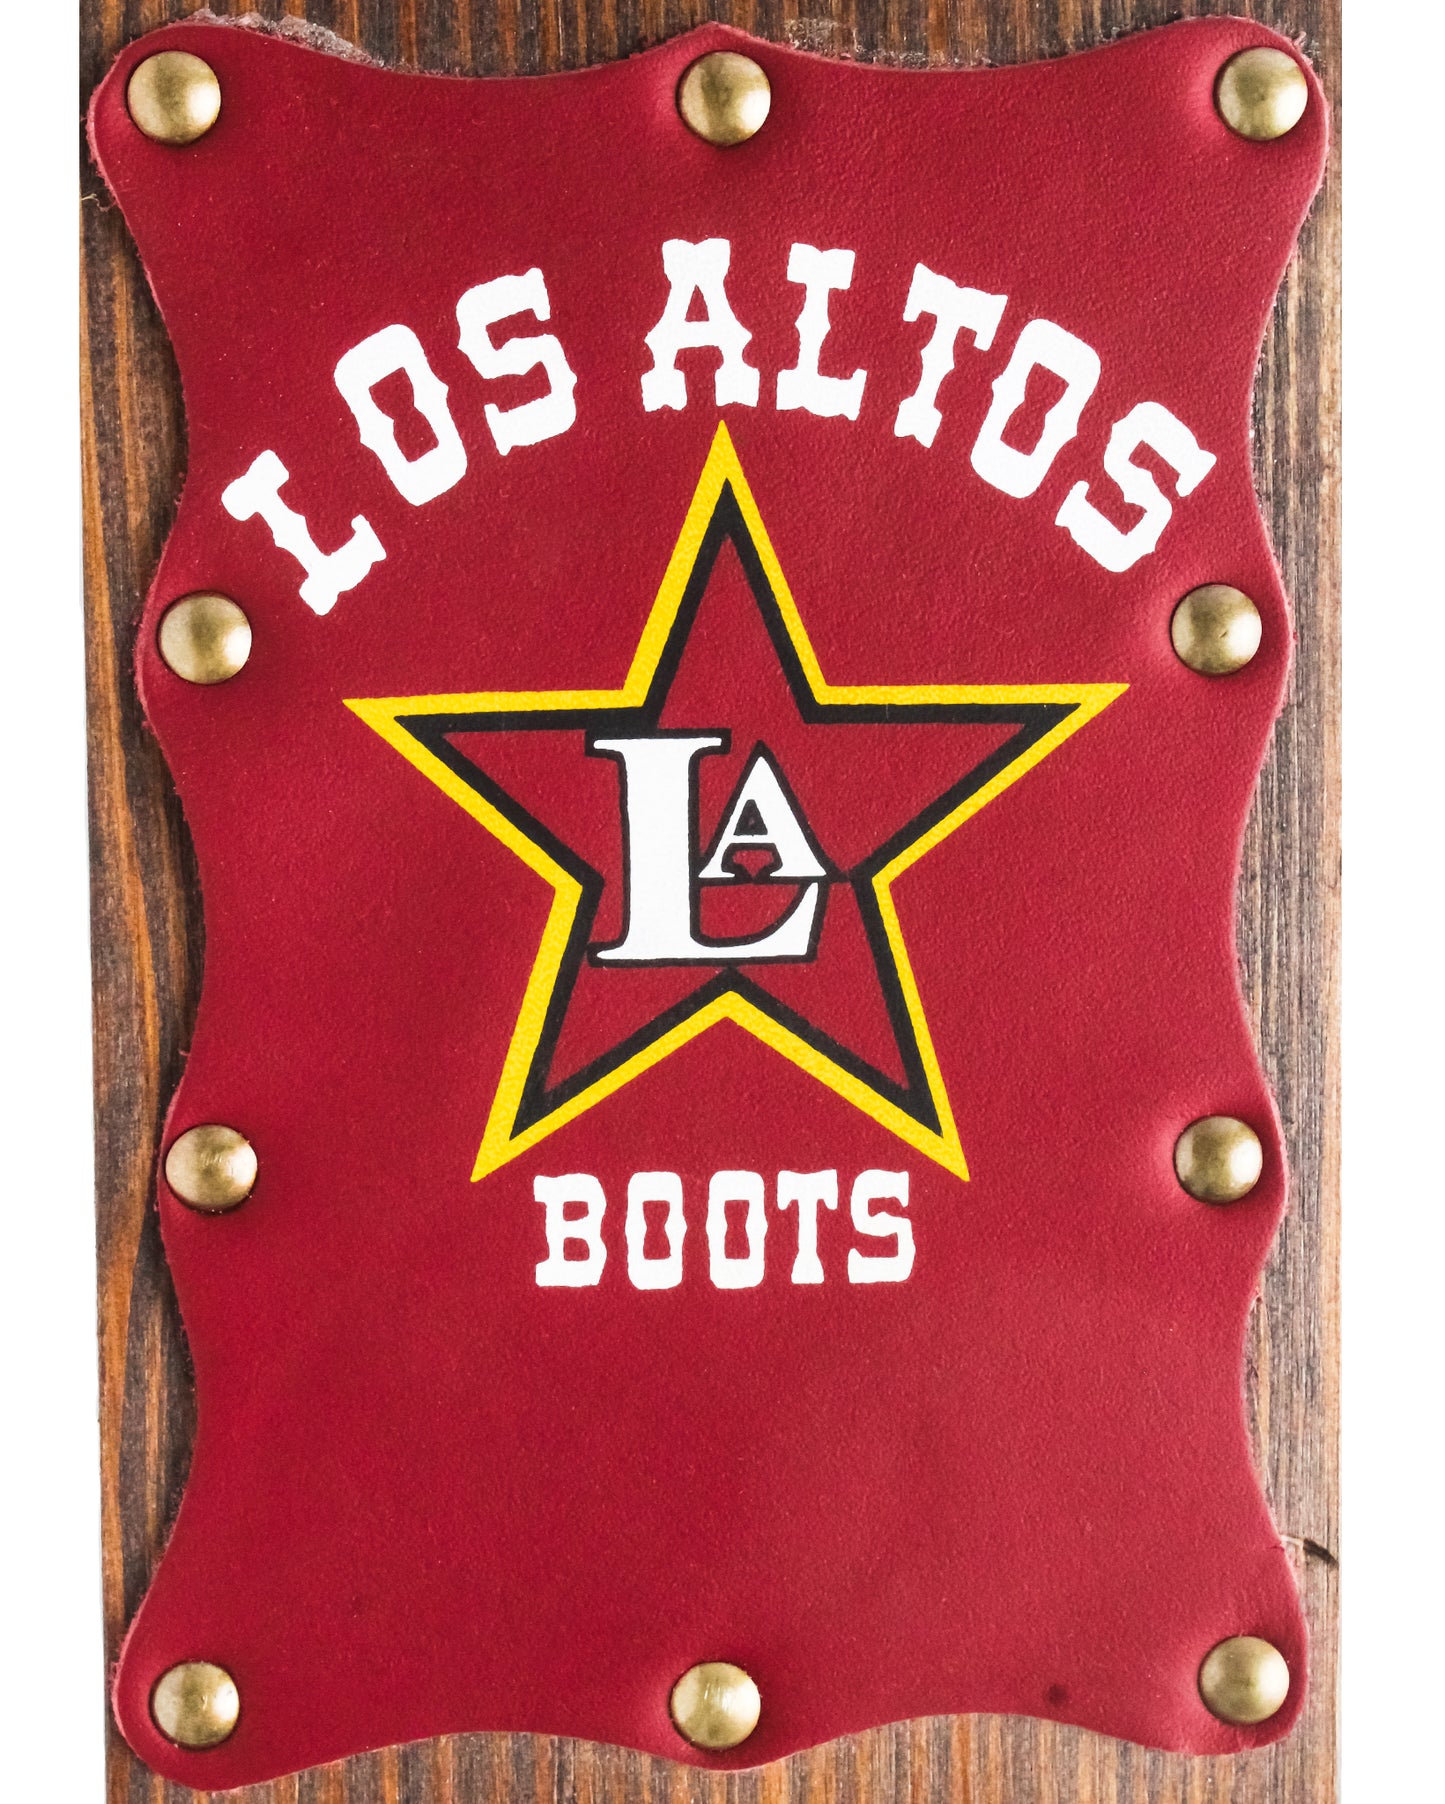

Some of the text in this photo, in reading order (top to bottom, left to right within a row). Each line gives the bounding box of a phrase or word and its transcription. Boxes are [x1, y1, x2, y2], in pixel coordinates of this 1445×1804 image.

[221, 238, 1218, 616] LOS ALTOS
[592, 735, 828, 962] LA
[534, 1169, 917, 1290] BOOTS
